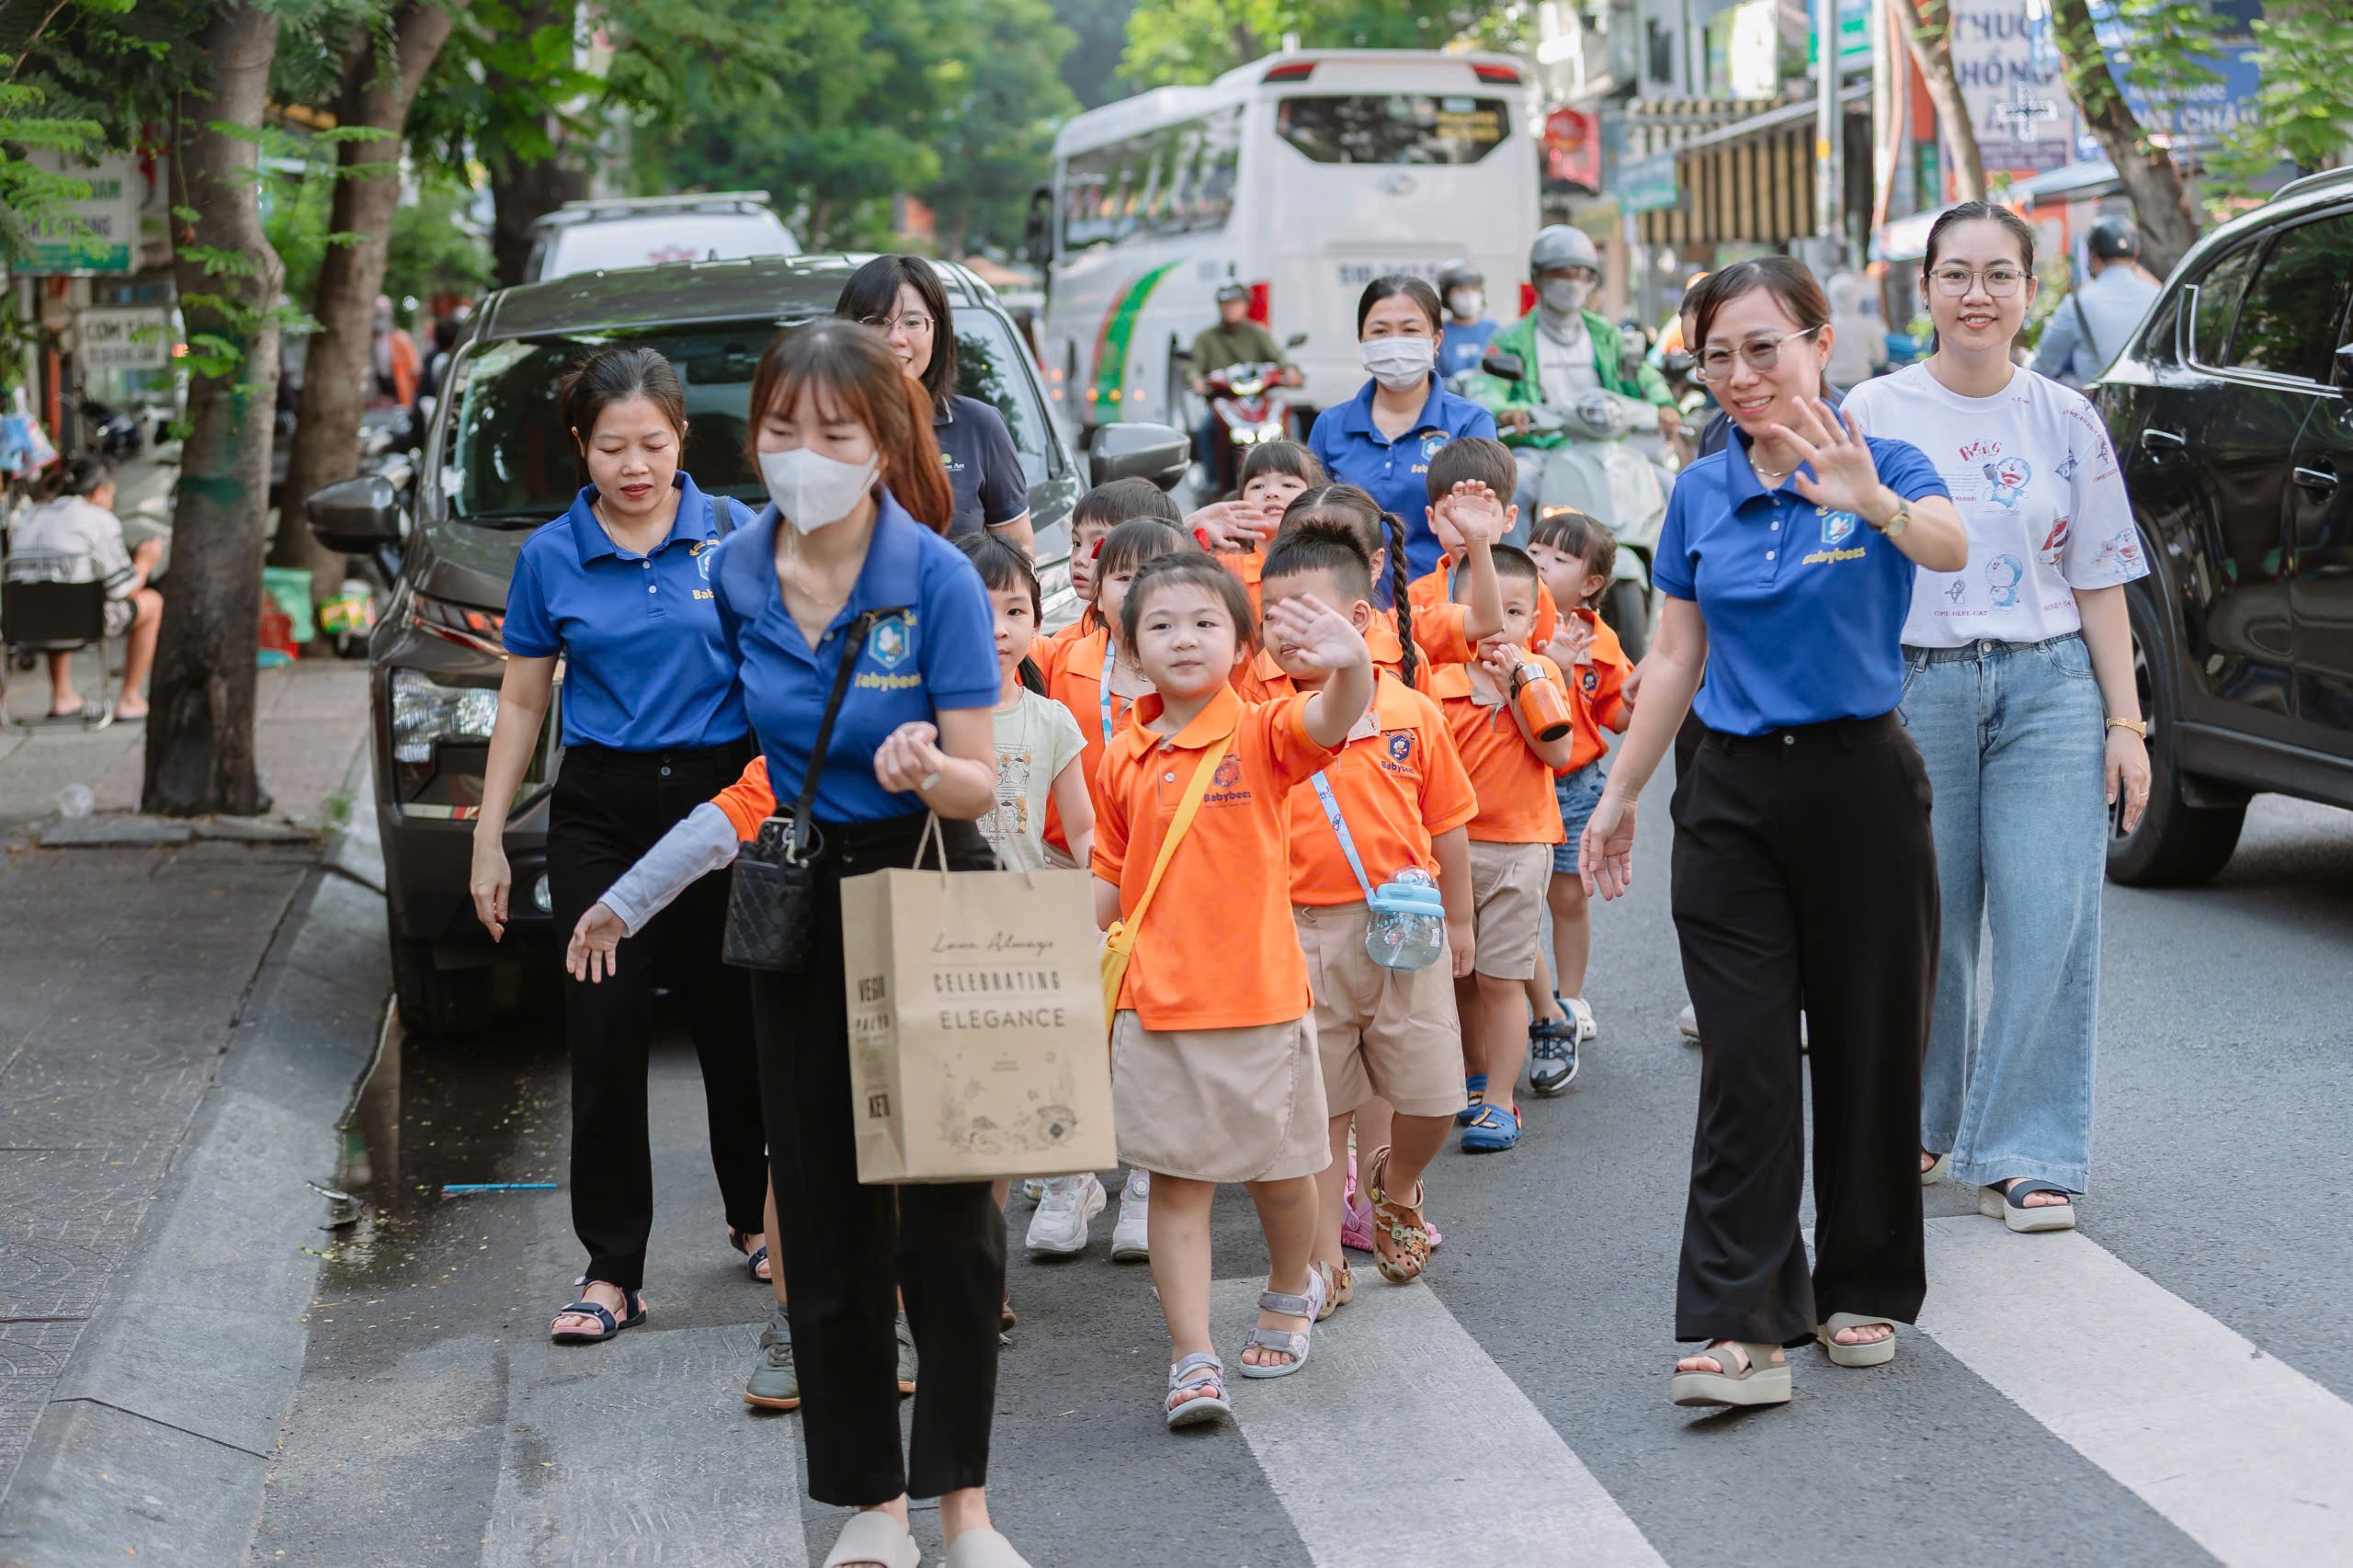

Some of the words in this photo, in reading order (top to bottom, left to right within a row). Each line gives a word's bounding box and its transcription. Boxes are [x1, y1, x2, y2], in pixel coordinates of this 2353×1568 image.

[1203, 790, 1251, 803] Babybees
[934, 971, 1061, 993] CELEBRATING
[939, 1008, 1066, 1030] ELEGANCE
